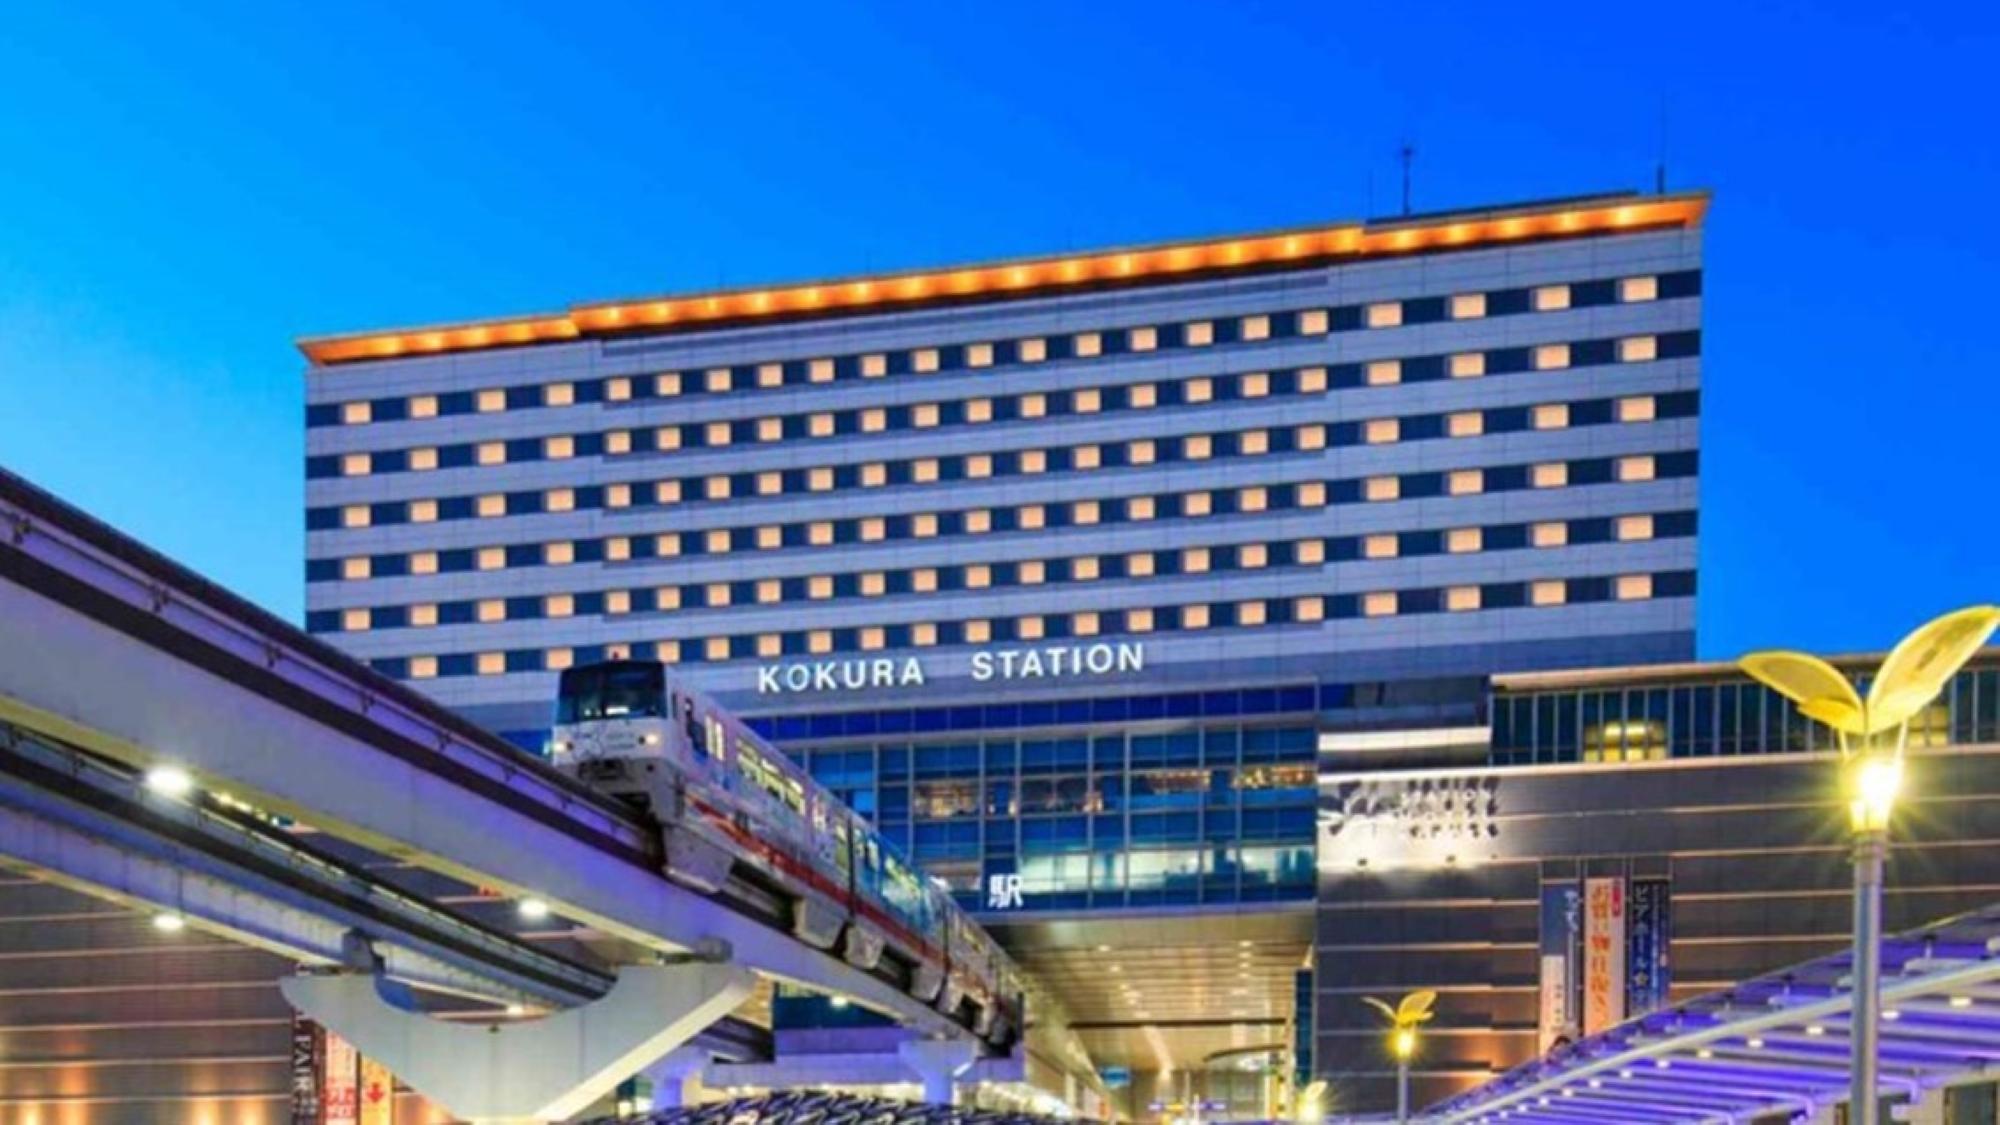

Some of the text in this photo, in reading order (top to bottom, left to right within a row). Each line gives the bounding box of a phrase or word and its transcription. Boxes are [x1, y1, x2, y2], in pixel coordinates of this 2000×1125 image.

[757, 643, 1144, 694] KOKURA STATION
[988, 873, 1024, 909] 駅
